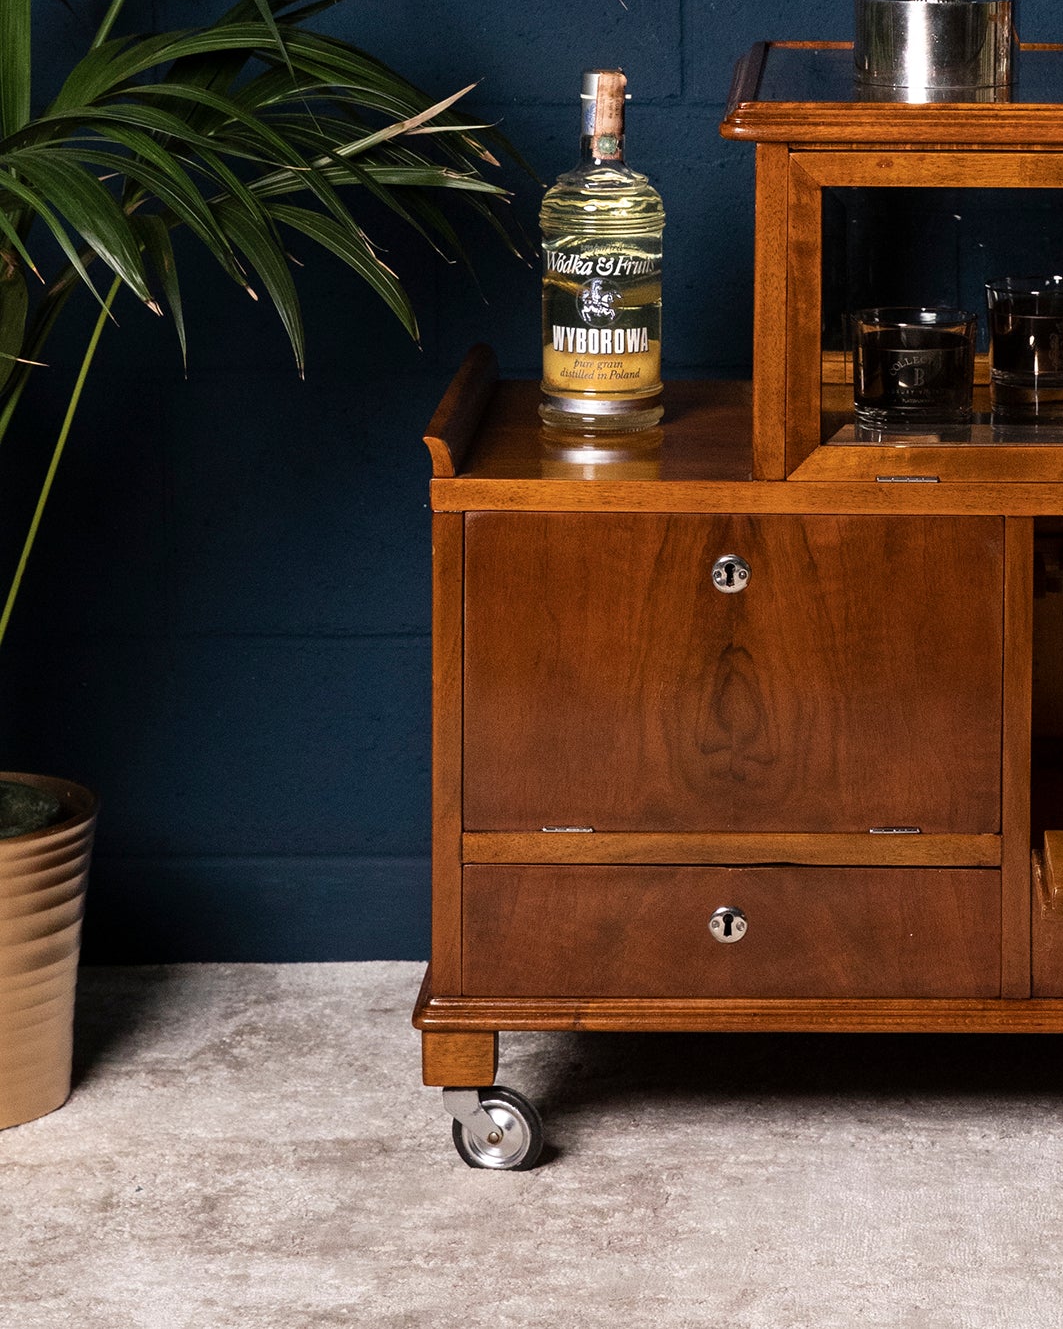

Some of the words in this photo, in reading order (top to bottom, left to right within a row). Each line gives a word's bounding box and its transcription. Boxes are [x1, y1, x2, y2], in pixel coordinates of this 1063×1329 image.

[546, 250, 594, 276] Wódka
[595, 257, 615, 276] &
[552, 324, 649, 354] WYBOROWA
[560, 368, 594, 380] distilled
[597, 372, 607, 380] in
[609, 368, 641, 380] Poland
[573, 359, 594, 369] pure
[597, 360, 623, 370] grain
[913, 367, 926, 387] B
